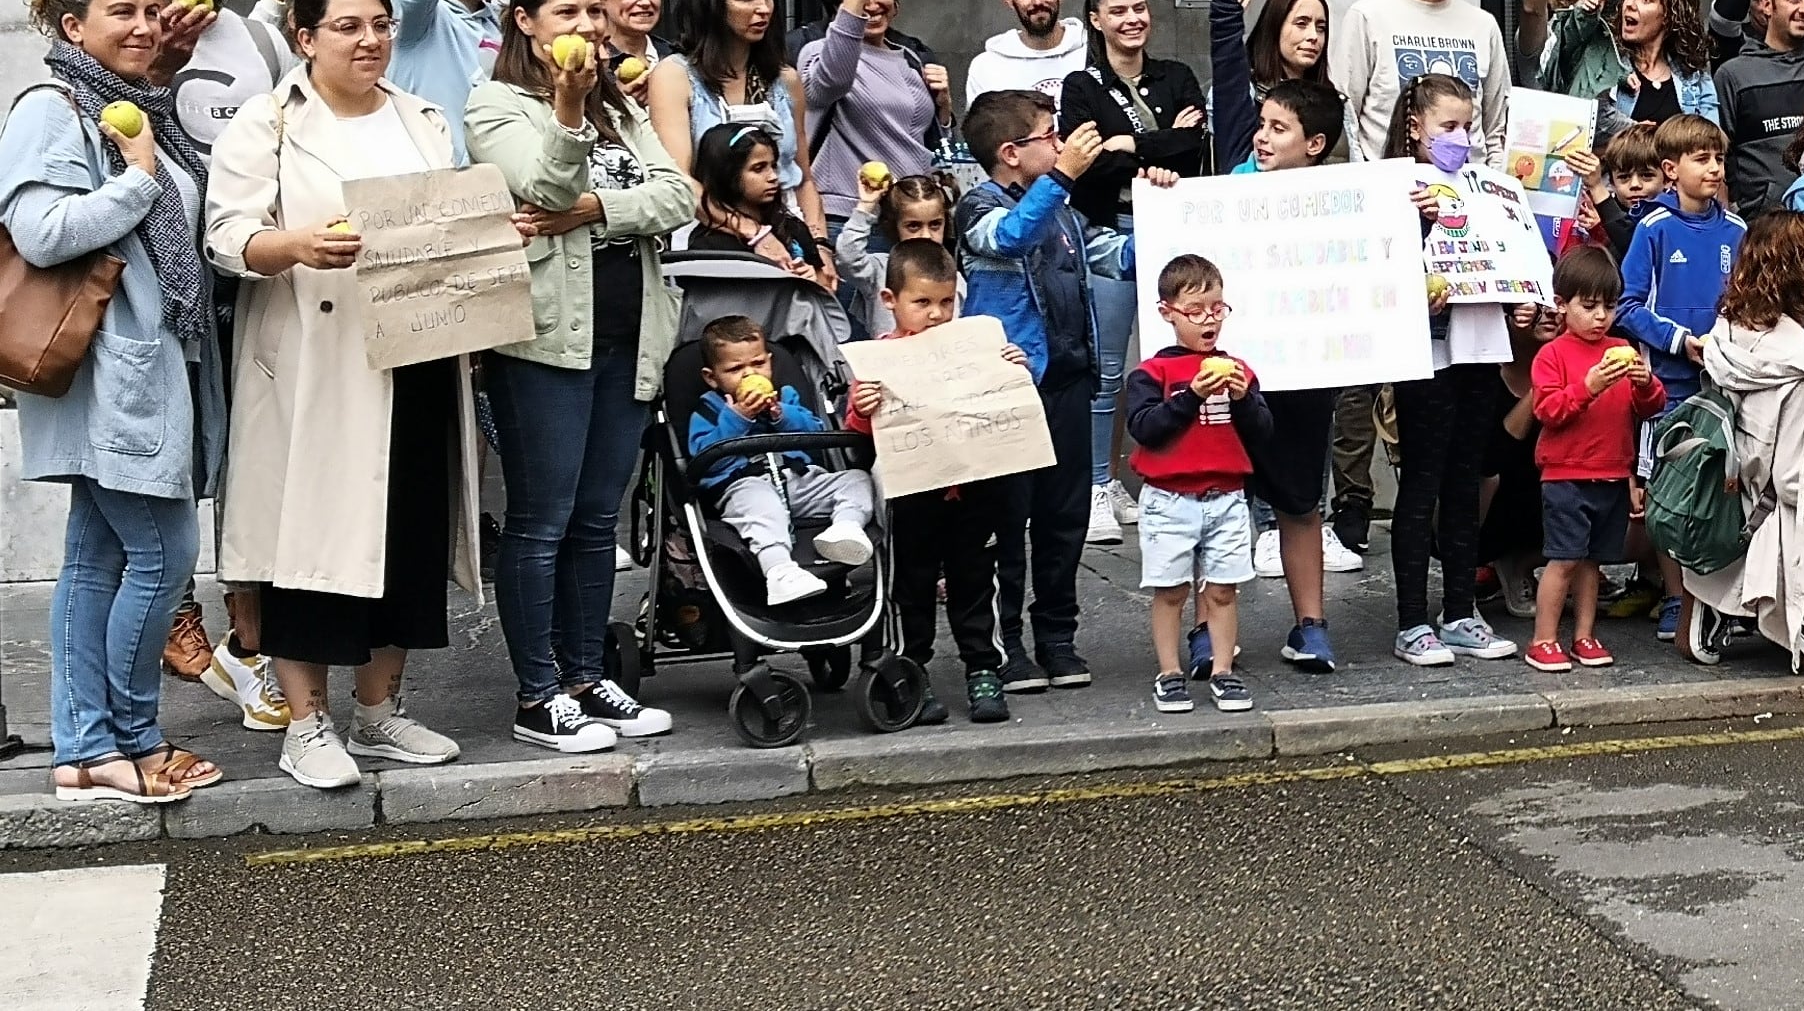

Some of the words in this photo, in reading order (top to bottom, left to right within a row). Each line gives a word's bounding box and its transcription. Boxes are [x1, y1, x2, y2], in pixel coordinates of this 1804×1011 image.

[1392, 34, 1438, 48] CHARLIE
[1438, 36, 1476, 51] BROWN
[1762, 117, 1781, 133] THE
[359, 209, 396, 232] POR
[403, 200, 431, 226] UN
[1182, 200, 1225, 225] POR
[1237, 197, 1270, 223] UN
[1276, 188, 1366, 222] COMEDOR
[364, 241, 454, 271] SALUDABLE
[1380, 236, 1394, 261] Y
[487, 261, 527, 286] SEPT
[375, 320, 386, 340] A
[410, 303, 467, 333] JUNIO
[890, 425, 934, 454] LOS
